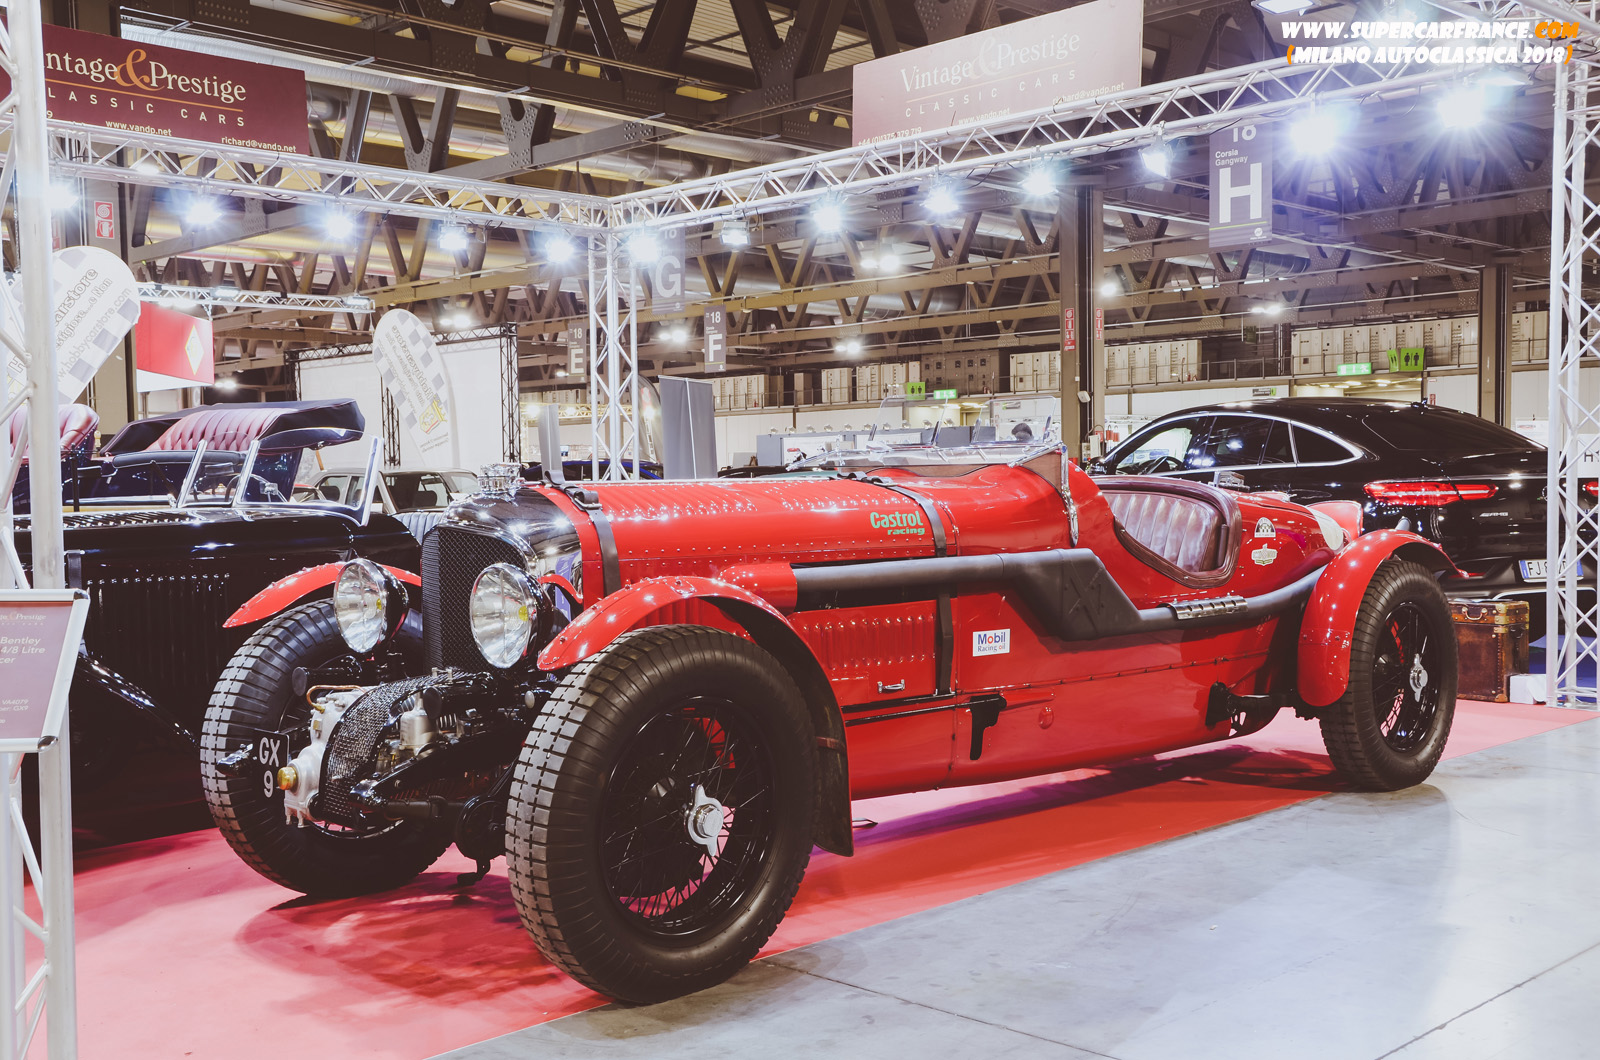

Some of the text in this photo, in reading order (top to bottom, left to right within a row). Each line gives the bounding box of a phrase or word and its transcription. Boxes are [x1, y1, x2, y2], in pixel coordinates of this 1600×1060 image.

[900, 60, 972, 93] Vintage
[996, 33, 1080, 71] Prestige
[45, 51, 119, 83] ntage
[149, 60, 246, 104] Prestige
[905, 69, 1076, 117] CLASSIC CARS
[48, 87, 245, 127] LASSIC CARS
[958, 107, 1011, 126] www.vandp.net
[105, 120, 172, 137] www.vandp.net
[221, 136, 297, 153] richard@vandp.net
[1215, 148, 1239, 159] Corsia
[1215, 155, 1249, 167] Gangway
[1219, 162, 1263, 224] H
[655, 255, 682, 298] G
[710, 311, 721, 324] 18
[57, 287, 132, 383] w.hobbycarstore.com
[573, 327, 583, 339] 18
[709, 334, 723, 362] F
[571, 348, 584, 374] E
[870, 510, 923, 529] Castrol
[887, 527, 925, 535] racing
[0, 636, 41, 646] Bentley
[977, 631, 1006, 645] Mobil
[977, 642, 1006, 653] Racing oil
[21, 646, 46, 654] Litre
[259, 736, 280, 768] GX
[263, 770, 274, 798] 9
